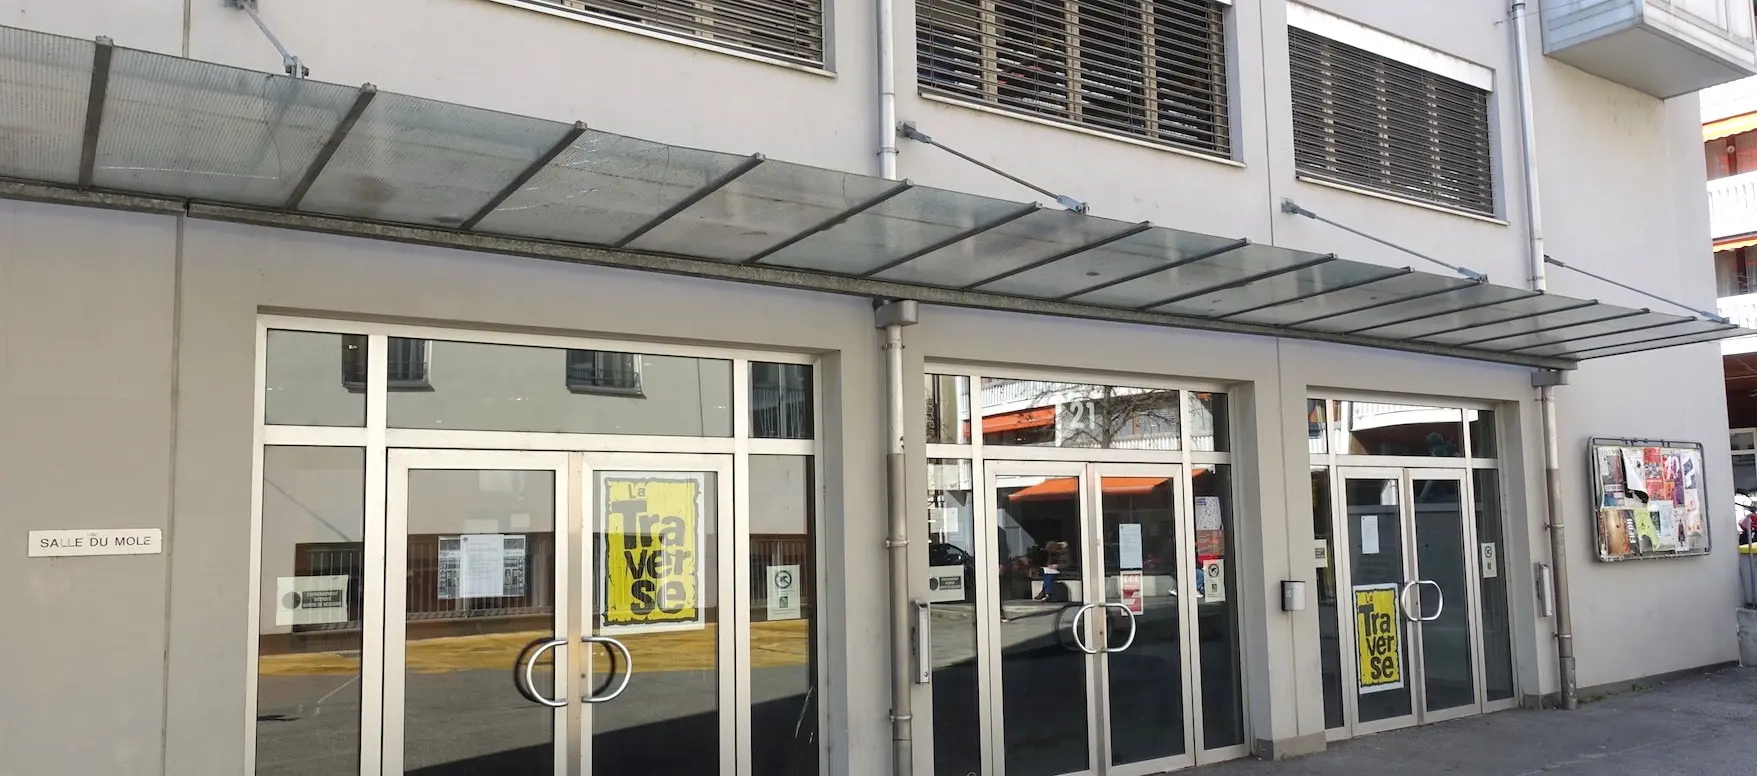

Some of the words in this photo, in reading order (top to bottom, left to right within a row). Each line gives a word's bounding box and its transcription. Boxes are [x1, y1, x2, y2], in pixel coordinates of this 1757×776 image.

[1070, 401, 1095, 429] 21
[627, 483, 646, 499] La
[611, 500, 686, 550] Tra
[40, 537, 83, 548] SALLE
[89, 537, 108, 547] DU
[114, 536, 151, 546] MOLE
[624, 548, 692, 580] ver
[630, 579, 687, 615] se
[1358, 604, 1391, 637] Tra
[1366, 634, 1395, 657] ver
[1370, 656, 1394, 680] se
